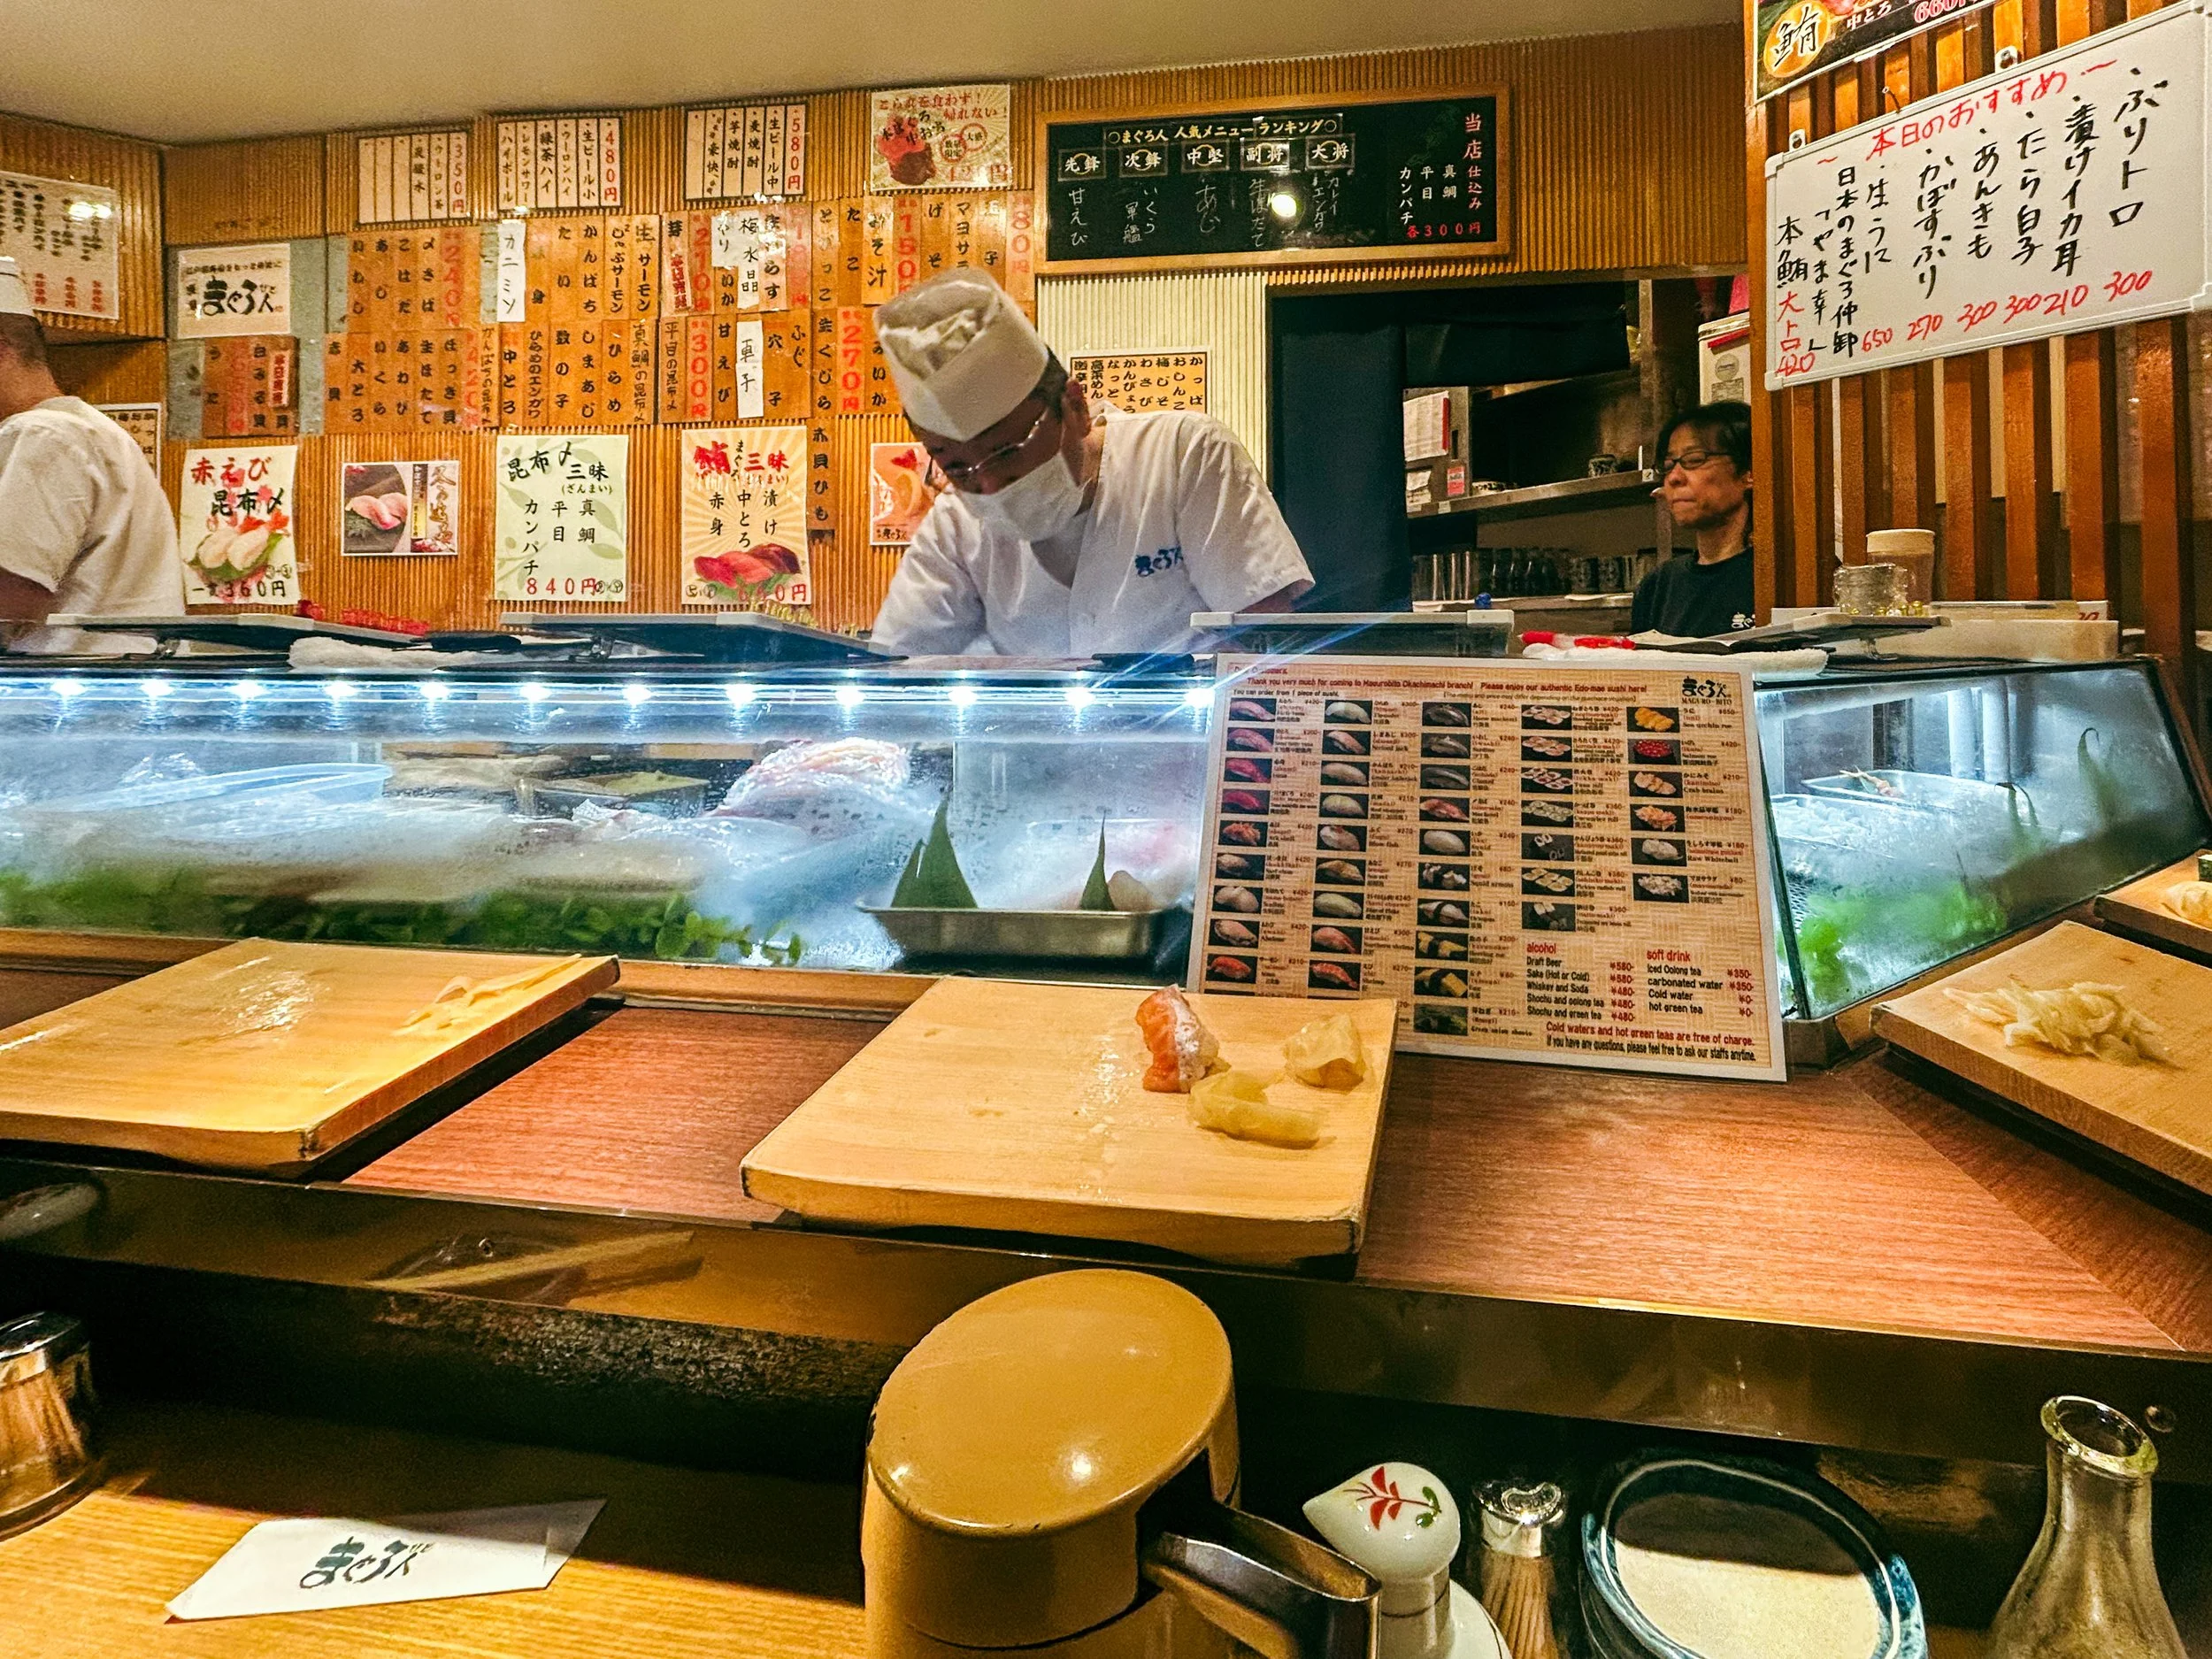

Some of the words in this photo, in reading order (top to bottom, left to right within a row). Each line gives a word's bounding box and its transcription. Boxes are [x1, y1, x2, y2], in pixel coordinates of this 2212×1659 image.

[1773, 5, 1821, 68] 鮪
[1847, 3, 1893, 30] 中とろ
[1122, 130, 1169, 143] まぐろ人
[1174, 125, 1254, 139] 人気メニュー
[1259, 119, 1325, 134] ランキング
[1865, 71, 2067, 161] 本日のおすすめ
[539, 132, 554, 194] 緑茶ハイ
[562, 131, 572, 196] ウーロンハイ
[582, 129, 595, 201] 生ビール小
[603, 130, 618, 202] 480円
[726, 120, 741, 169] 芋焼酎
[747, 119, 761, 168] 麦焼酎
[767, 117, 780, 189] 生ビール中
[788, 118, 801, 190] 580円
[1064, 156, 1101, 173] 先鋒
[1125, 153, 1162, 168] 次鋒
[1187, 148, 1224, 165] 中堅
[1247, 142, 1284, 163] 副将
[1312, 142, 1349, 160] 大将
[1463, 112, 1483, 210] 当店仕込み
[2109, 80, 2169, 227] ぶりトロ
[503, 134, 514, 203] ハイボール
[522, 134, 531, 203] レモンサワー
[1420, 165, 1434, 200] 平目
[1442, 164, 1457, 199] 真鯛
[1069, 188, 1088, 246] 甘えび
[1399, 166, 1414, 225] カンパチ
[1968, 142, 2001, 259] あんきも
[2011, 128, 2046, 265] たら白子
[846, 207, 861, 272] たこ
[929, 202, 944, 268] げそ
[1407, 222, 1480, 239] 各300円
[1865, 179, 1892, 274] 生うに
[375, 239, 388, 300] あじ
[398, 238, 411, 314] こはだ
[502, 234, 518, 314] カニミソ
[558, 227, 571, 288] たい
[1830, 166, 1858, 358] 日本のまぐろ仲卸
[2003, 293, 2043, 325] 300
[2043, 284, 2089, 317] 210
[2103, 270, 2153, 302] 300
[1862, 327, 1893, 352] 650
[1907, 314, 1943, 341] 270
[1957, 301, 1998, 333] 300
[373, 341, 387, 415] いくら
[503, 349, 517, 414] 中とろ
[556, 330, 570, 407] 数の子
[580, 330, 595, 419] しまあじ
[607, 343, 622, 413] ひらめ
[718, 324, 732, 403] 甘えび
[767, 334, 783, 408] 穴子
[1140, 357, 1153, 407] わさび
[1156, 357, 1170, 406] 梅じそ
[1172, 357, 1187, 411] おしんこ
[1776, 351, 1816, 377] 420
[352, 359, 365, 423] 大とろ
[191, 457, 272, 486] 赤えび
[744, 450, 789, 472] 三昧
[813, 427, 829, 521] 赤貝ひも
[211, 488, 285, 517] 昆布〆
[552, 501, 568, 541] 平目
[578, 499, 595, 543] 真鯛
[709, 492, 725, 535] 赤身
[737, 489, 751, 548] 中とろ
[764, 490, 779, 535] 漬け
[523, 499, 539, 575] カンパチ
[526, 578, 595, 595] 840円
[1480, 681, 1503, 690] Please
[1505, 683, 1524, 692] enjoy
[1526, 956, 1544, 965] Draft
[1546, 957, 1562, 967] Beer
[1527, 942, 1556, 954] alcohol
[1647, 949, 1664, 960] soft
[1667, 949, 1691, 962] drink
[1647, 964, 1662, 973] Iced
[1663, 964, 1688, 976] Oolong
[1690, 966, 1701, 976] tea
[1526, 969, 1543, 979] Sake
[1546, 970, 1560, 979] (Hot
[1571, 972, 1590, 982] Cold)
[1526, 981, 1553, 992] Whiskey
[1571, 984, 1589, 994] Soda
[1647, 977, 1696, 988] carbonated
[1699, 980, 1724, 990] water
[1648, 988, 1667, 999] Cold
[1670, 991, 1694, 1001] water
[1527, 994, 1552, 1004] Shochu
[1555, 995, 1567, 1005] and
[1569, 996, 1591, 1008] oolong
[1594, 998, 1604, 1008] tea
[1527, 1005, 1552, 1017] Shochu
[1570, 1010, 1589, 1019] green
[1591, 1010, 1601, 1019] tea
[1649, 1002, 1662, 1011] hot
[1664, 1004, 1688, 1013] green
[1690, 1005, 1703, 1014] tea
[1547, 1021, 1564, 1033] Cold
[1567, 1024, 1595, 1034] waters
[1598, 1026, 1613, 1036] and
[1616, 1026, 1628, 1037] hot
[1631, 1029, 1654, 1039] green
[1656, 1029, 1674, 1041] teas
[1677, 1033, 1691, 1041] are
[1693, 1033, 1710, 1043] free
[1712, 1033, 1721, 1043] of
[1724, 1035, 1755, 1047] charge.
[1553, 1038, 1563, 1048] you
[1565, 1036, 1579, 1048] have
[1581, 1040, 1592, 1050] any
[1627, 1041, 1647, 1053] please
[1648, 1043, 1660, 1054] feel
[1662, 1043, 1674, 1055] free
[1676, 1044, 1683, 1056] to
[1685, 1046, 1695, 1056] ask
[1697, 1048, 1708, 1058] our
[1710, 1047, 1729, 1059] staffs
[1731, 1049, 1755, 1062] anytime.
